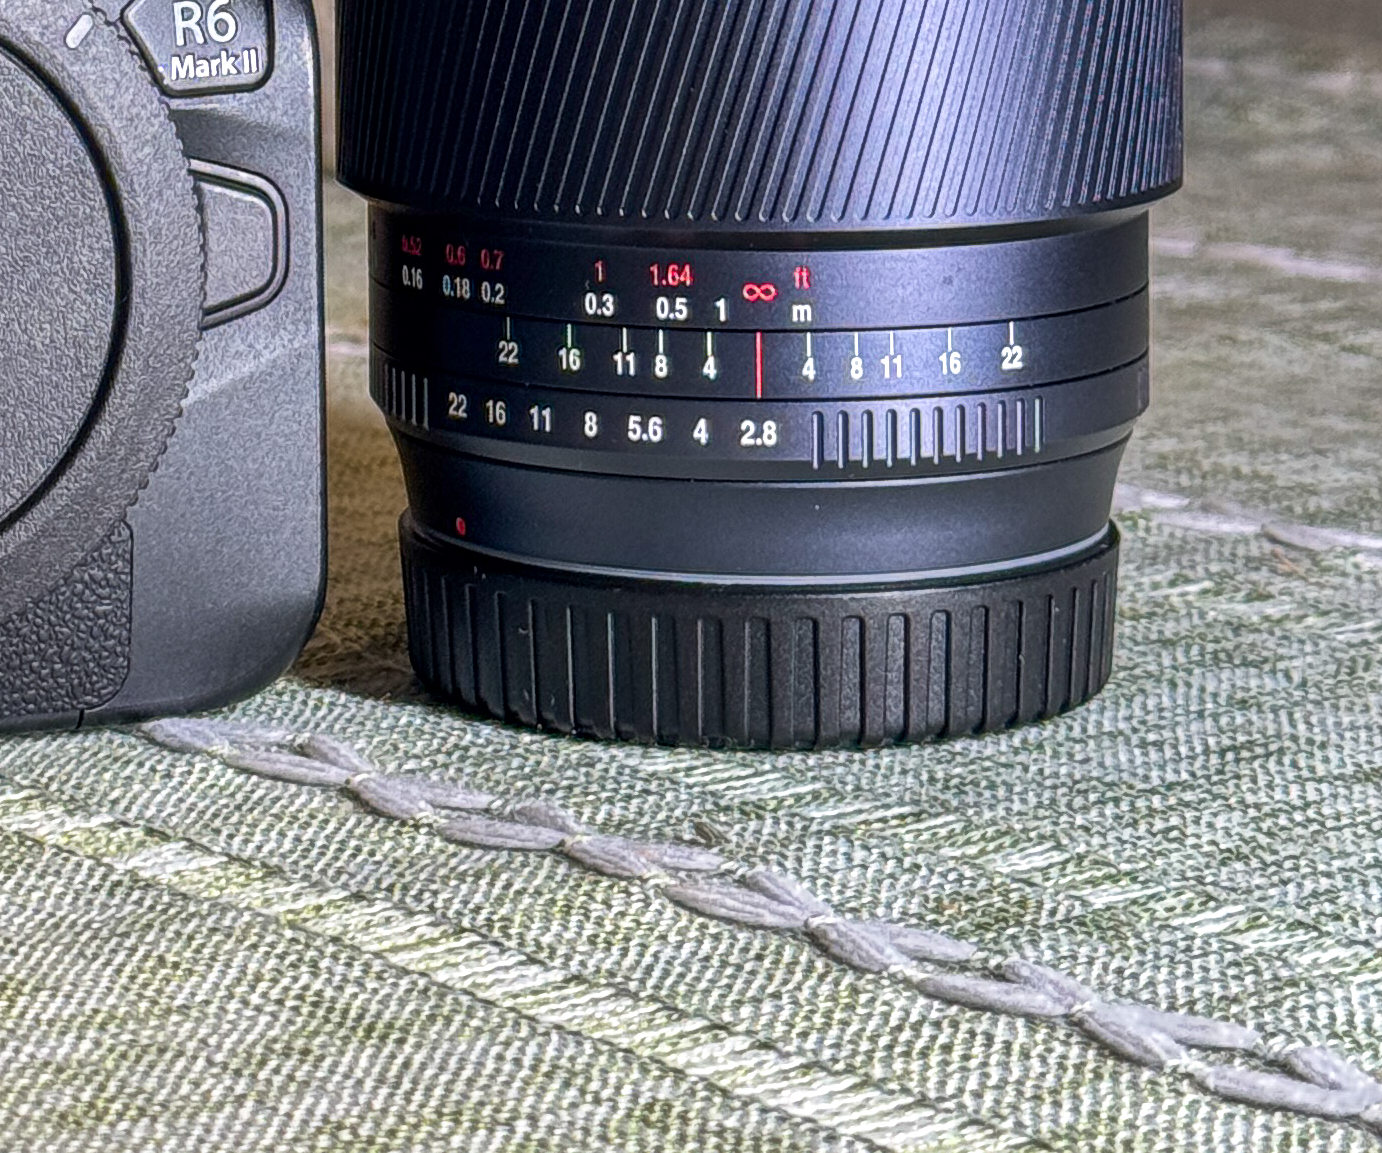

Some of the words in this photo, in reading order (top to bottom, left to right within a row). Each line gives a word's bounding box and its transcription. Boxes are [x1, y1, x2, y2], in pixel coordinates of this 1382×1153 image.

[171, 50, 238, 80] Mark
[243, 48, 259, 74] II
[445, 244, 466, 265] 0.6
[480, 248, 504, 270] 0.7
[594, 260, 604, 282] 1
[650, 263, 692, 286] 1.64
[794, 266, 811, 289] ft
[402, 265, 423, 289] 0.16
[442, 274, 470, 300] 0.18
[481, 281, 505, 305] 0.2
[584, 292, 615, 317] 0.3
[656, 296, 688, 321] 0.5
[715, 298, 727, 322] 1
[792, 303, 812, 322] m
[498, 341, 518, 365] 22
[558, 347, 581, 372] 16
[613, 352, 636, 376] 11
[654, 354, 668, 379] 8
[703, 355, 717, 381] 4
[801, 357, 816, 381] 4
[850, 357, 864, 380] 8
[881, 355, 902, 379] 11
[940, 351, 961, 375] 16
[1001, 346, 1023, 371] 22
[448, 392, 468, 419] 22
[486, 400, 507, 426] 16
[530, 406, 552, 433] 11
[584, 412, 599, 438] 8
[628, 416, 664, 442] 5.6
[693, 418, 709, 445] 4
[740, 420, 778, 446] 2.8
